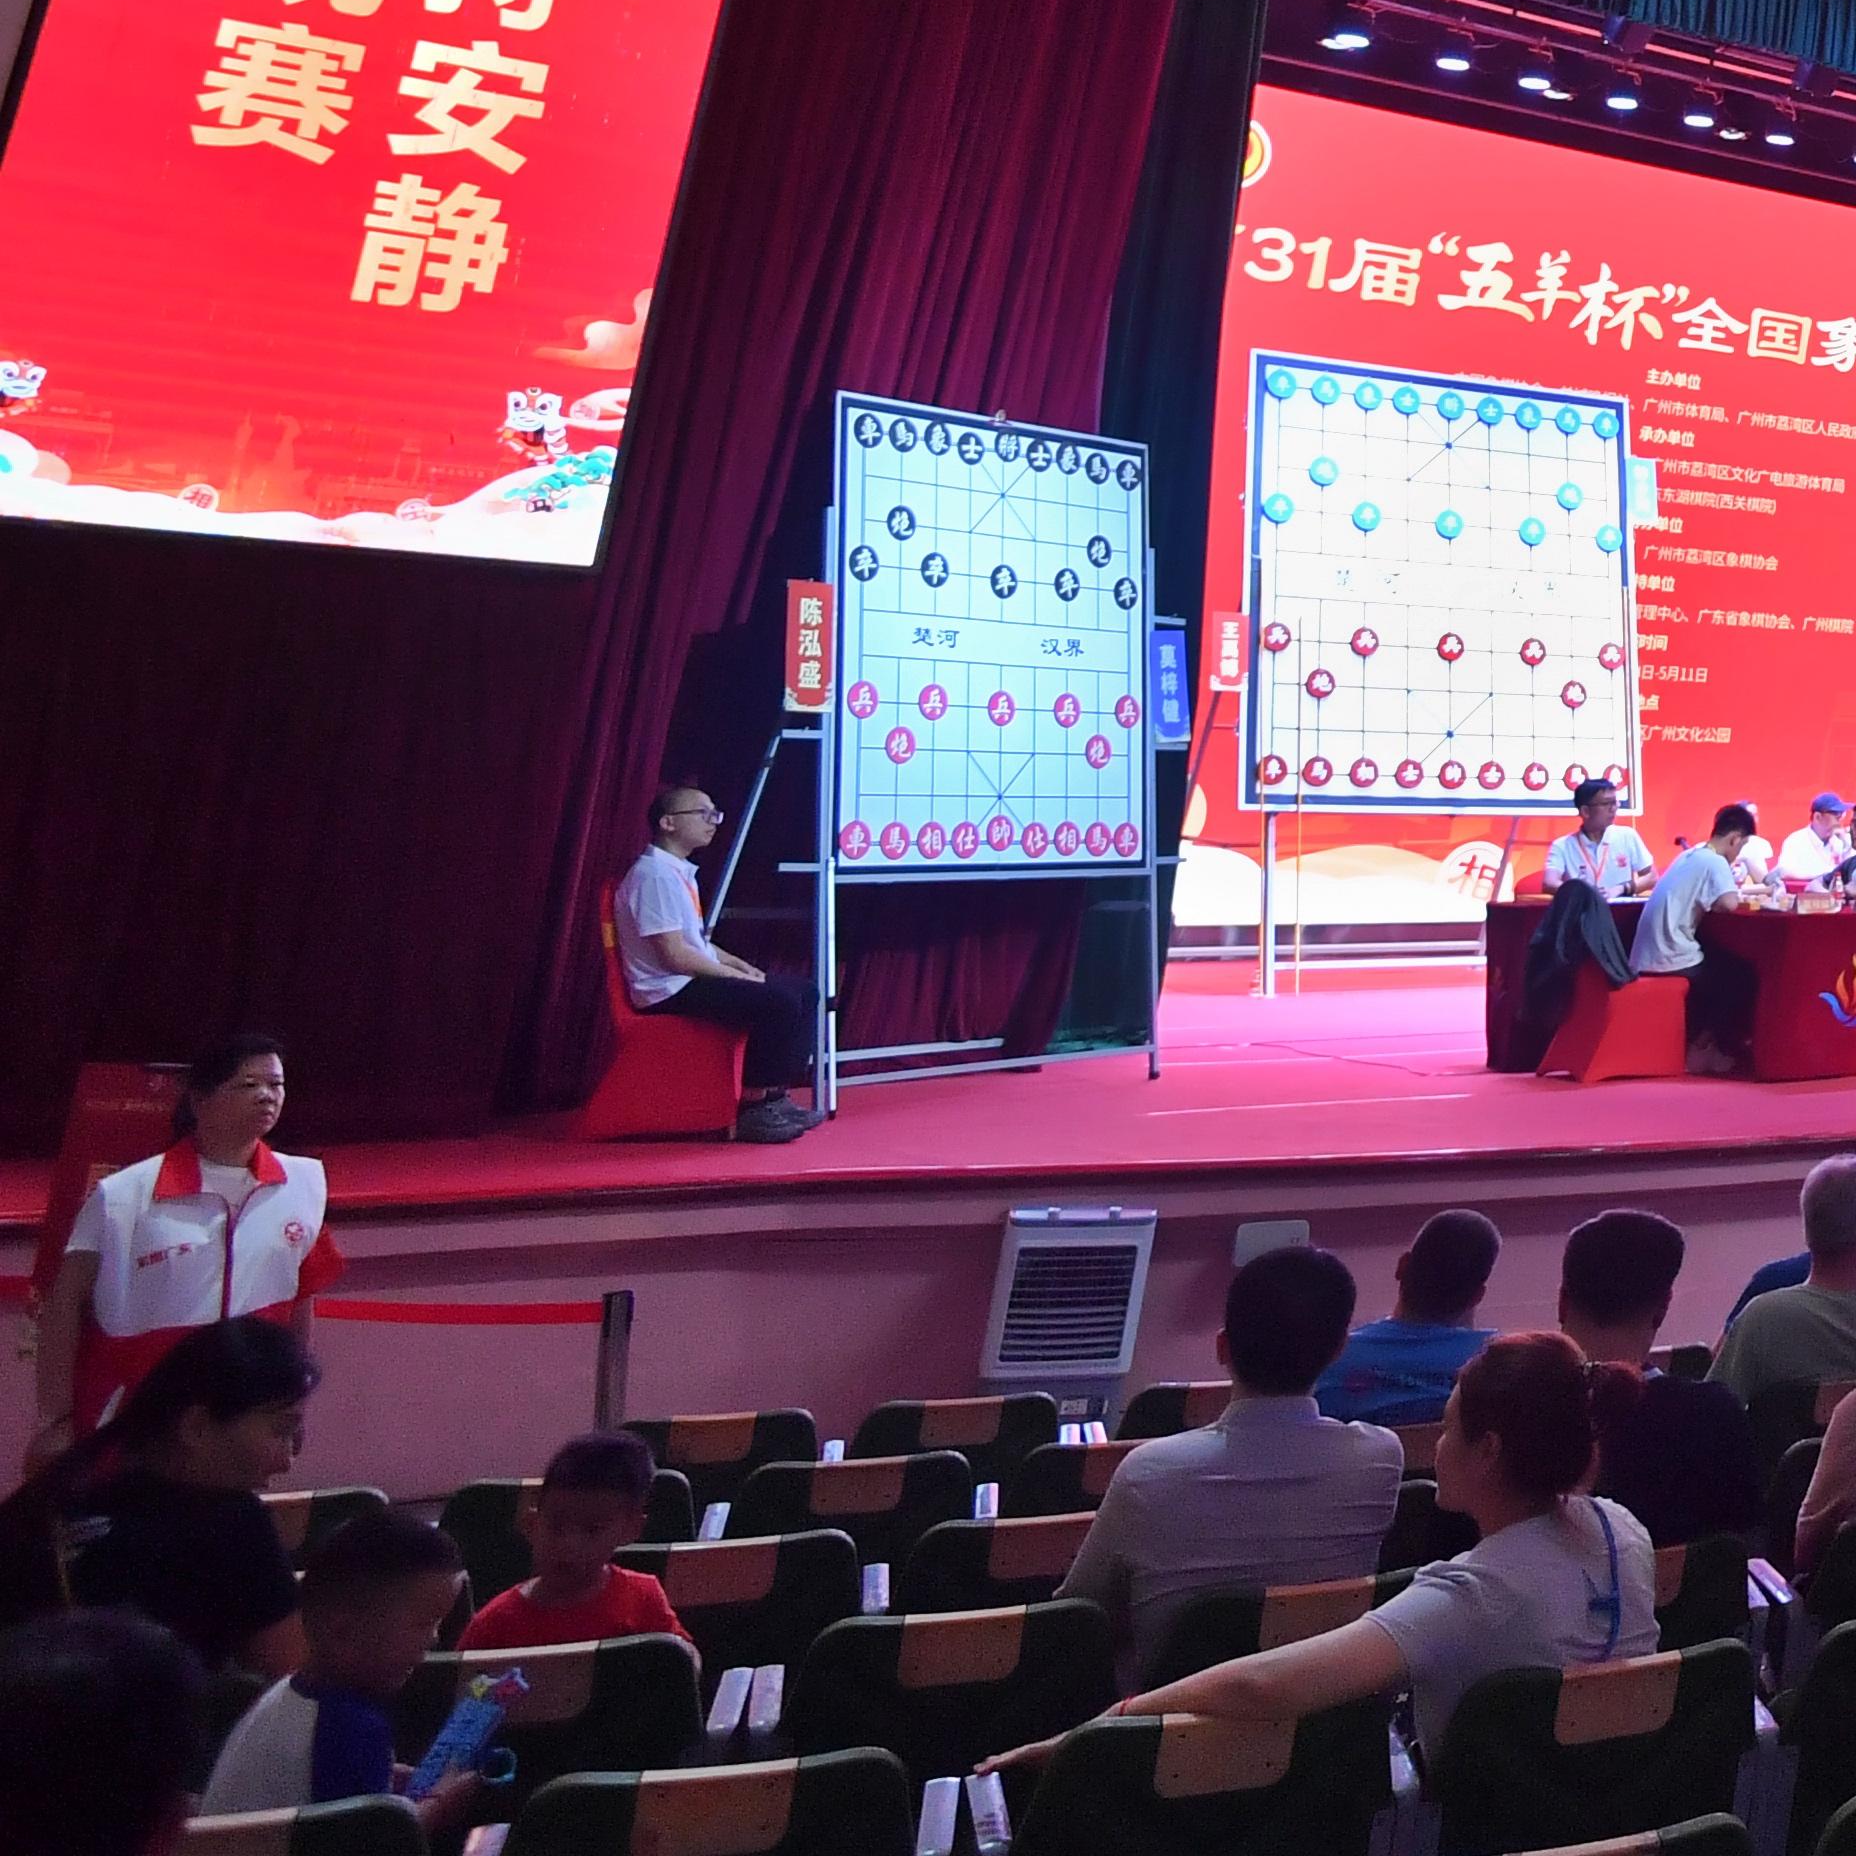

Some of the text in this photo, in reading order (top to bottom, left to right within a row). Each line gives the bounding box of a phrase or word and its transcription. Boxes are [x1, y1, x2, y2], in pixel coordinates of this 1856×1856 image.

[1645, 368, 1702, 391] 主办单位
[1638, 425, 1696, 448] 承办单位
[911, 626, 1086, 658] 楚河 汉界
[1638, 665, 1709, 683] 日-5月11日
